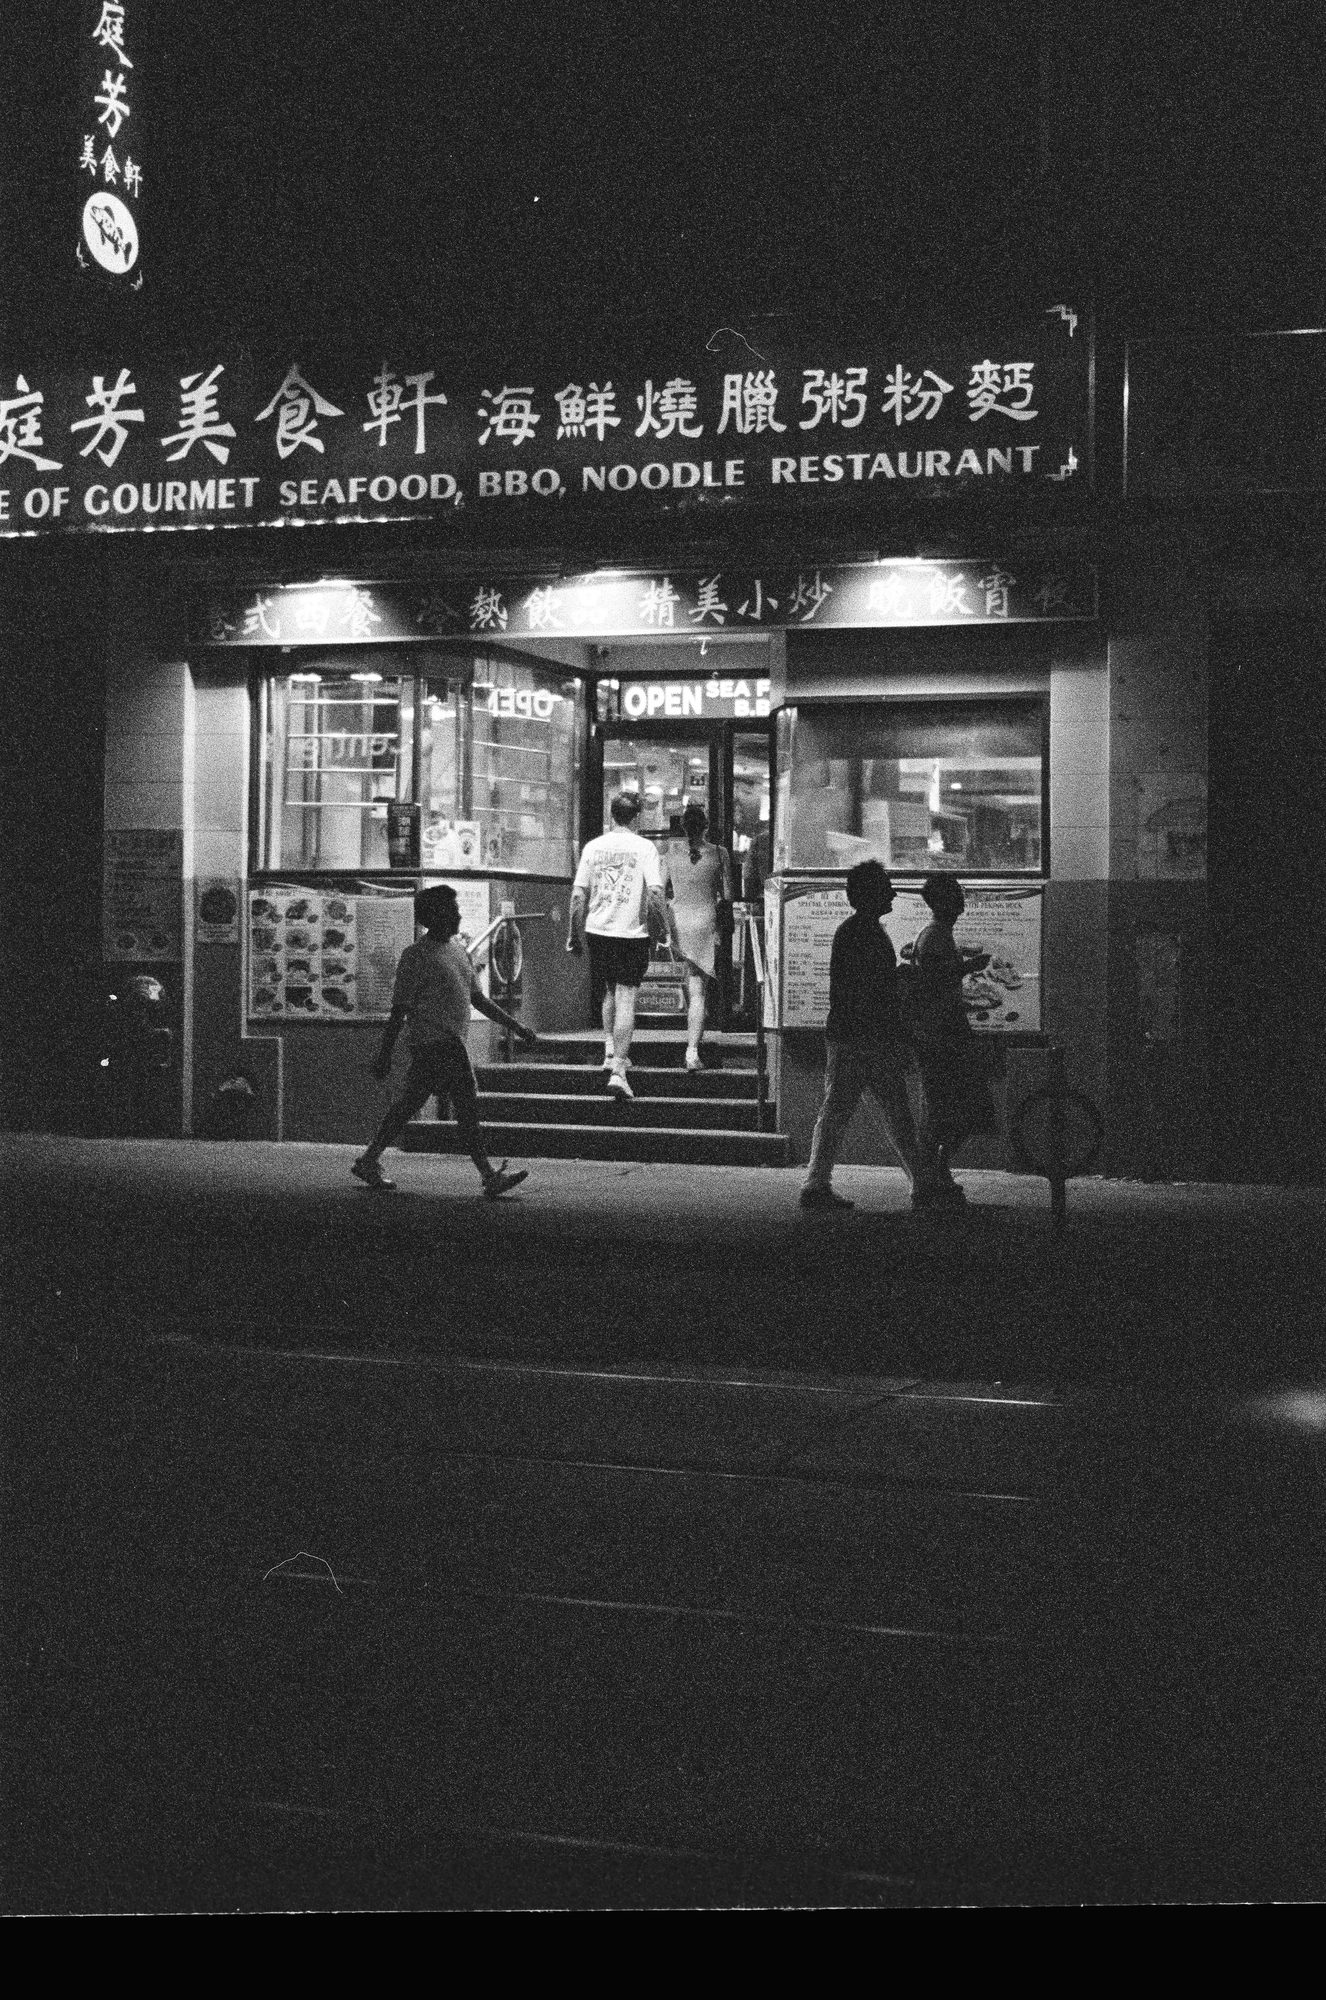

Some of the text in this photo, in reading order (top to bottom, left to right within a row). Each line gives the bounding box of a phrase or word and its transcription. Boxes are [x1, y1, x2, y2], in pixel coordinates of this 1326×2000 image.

[79, 134, 143, 199] 美食軒
[23, 486, 70, 518] OF
[84, 477, 260, 516] GOURMET
[280, 473, 463, 506] SEAFOOD,
[479, 468, 567, 500] BBQ,
[582, 460, 745, 493] NOODLE
[772, 446, 1040, 484] RESTAURANT
[638, 573, 834, 627] 精美小炒
[625, 685, 702, 716] OPEN
[706, 680, 750, 698] SEA
